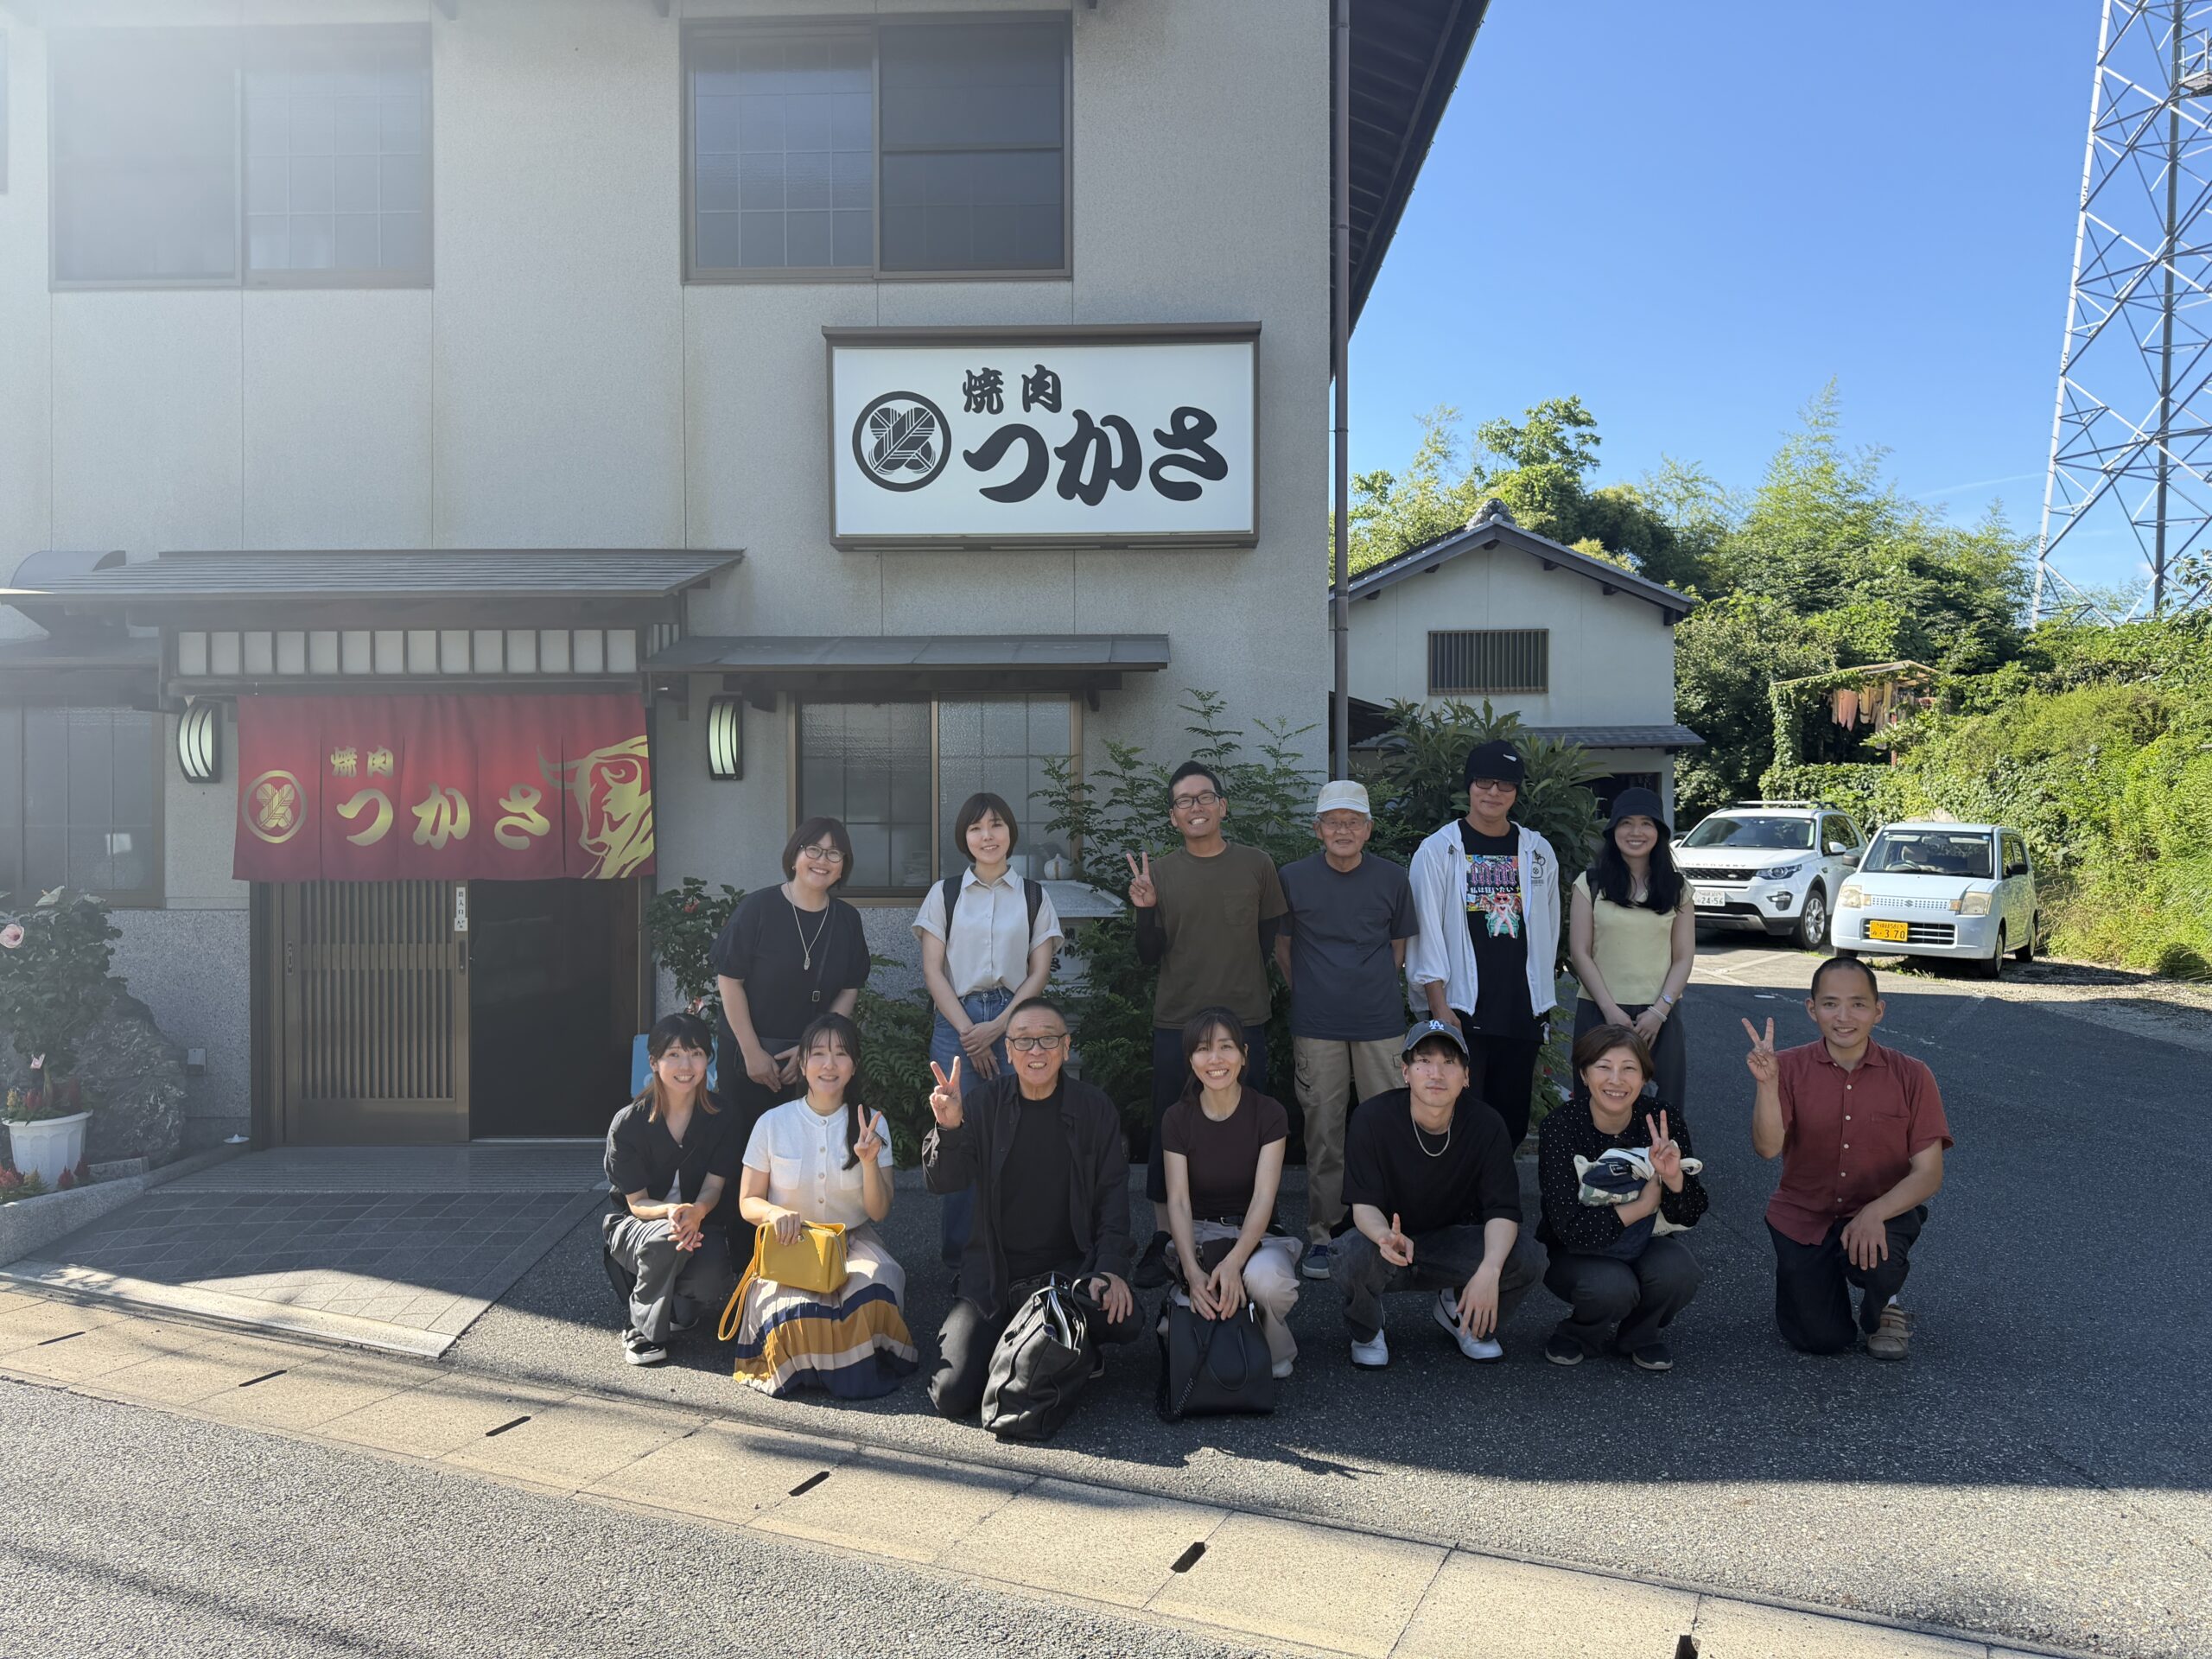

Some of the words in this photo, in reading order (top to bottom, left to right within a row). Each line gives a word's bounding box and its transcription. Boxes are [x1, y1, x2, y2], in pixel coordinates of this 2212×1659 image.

[963, 364, 1062, 415] 焼肉
[962, 406, 1229, 506] つかさ
[330, 746, 394, 779] 焼肉
[336, 781, 550, 850] つかさ
[1429, 1020, 1444, 1031] LA
